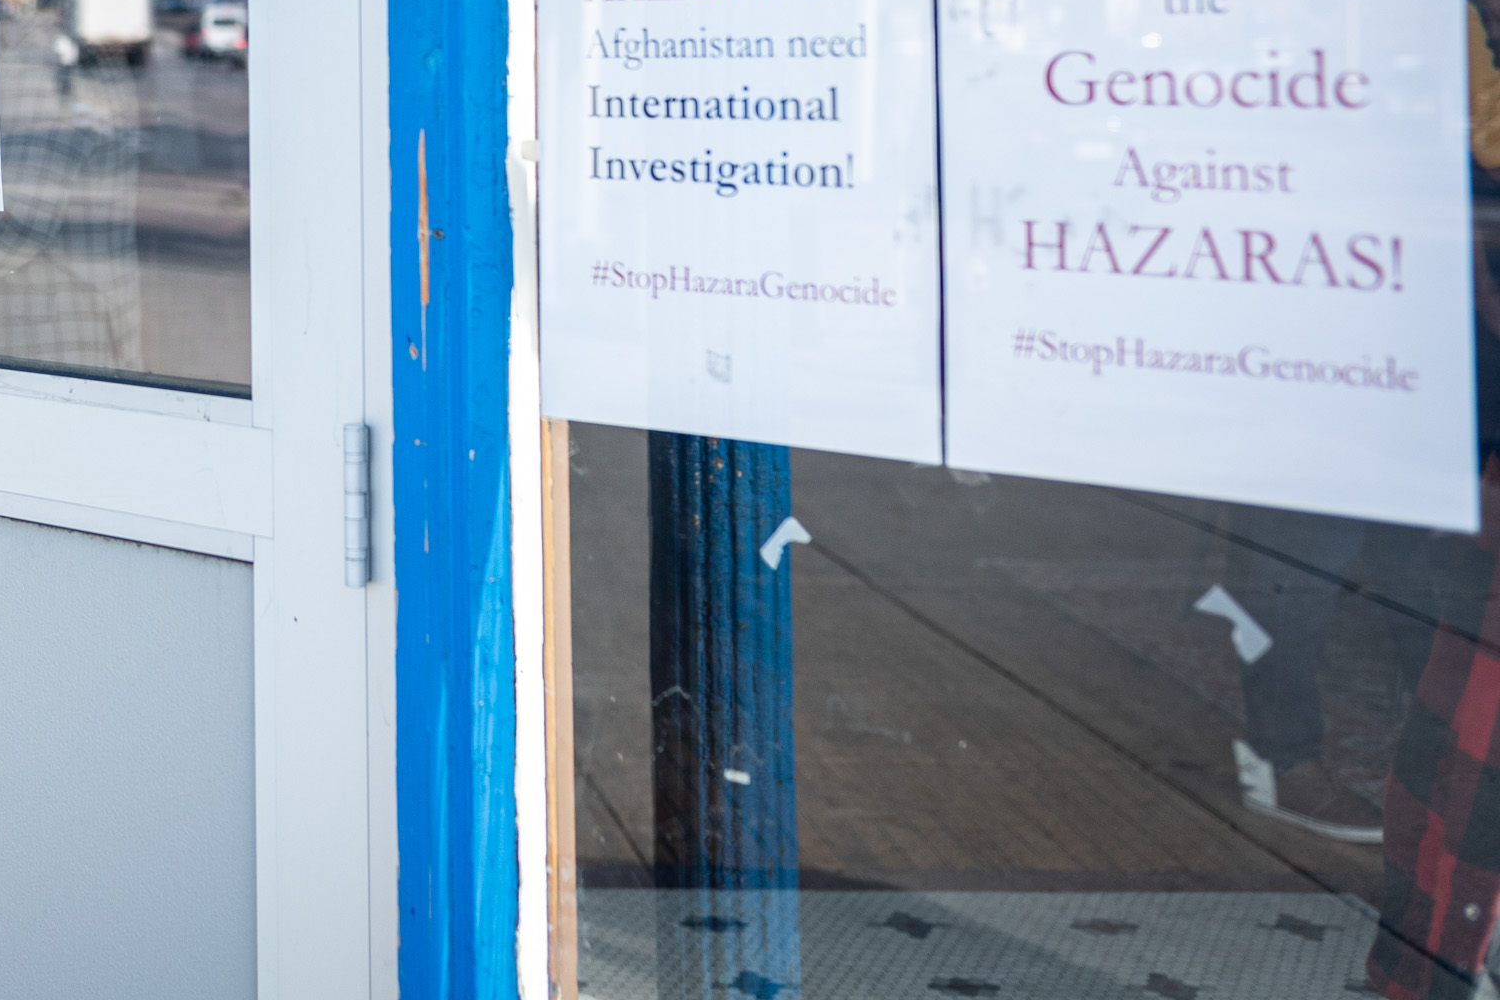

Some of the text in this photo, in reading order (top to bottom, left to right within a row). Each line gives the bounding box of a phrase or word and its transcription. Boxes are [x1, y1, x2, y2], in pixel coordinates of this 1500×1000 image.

[585, 24, 868, 70] Afghanistan need
[588, 85, 841, 123] International
[1043, 49, 1370, 111] Genocide
[589, 147, 855, 197] Investigation!
[1113, 146, 1296, 204] Against
[591, 260, 897, 307] #StopHazaraGenocide
[1019, 219, 1405, 294] HAZARAS!
[1011, 326, 1420, 393] #StopHazaraGenocide
